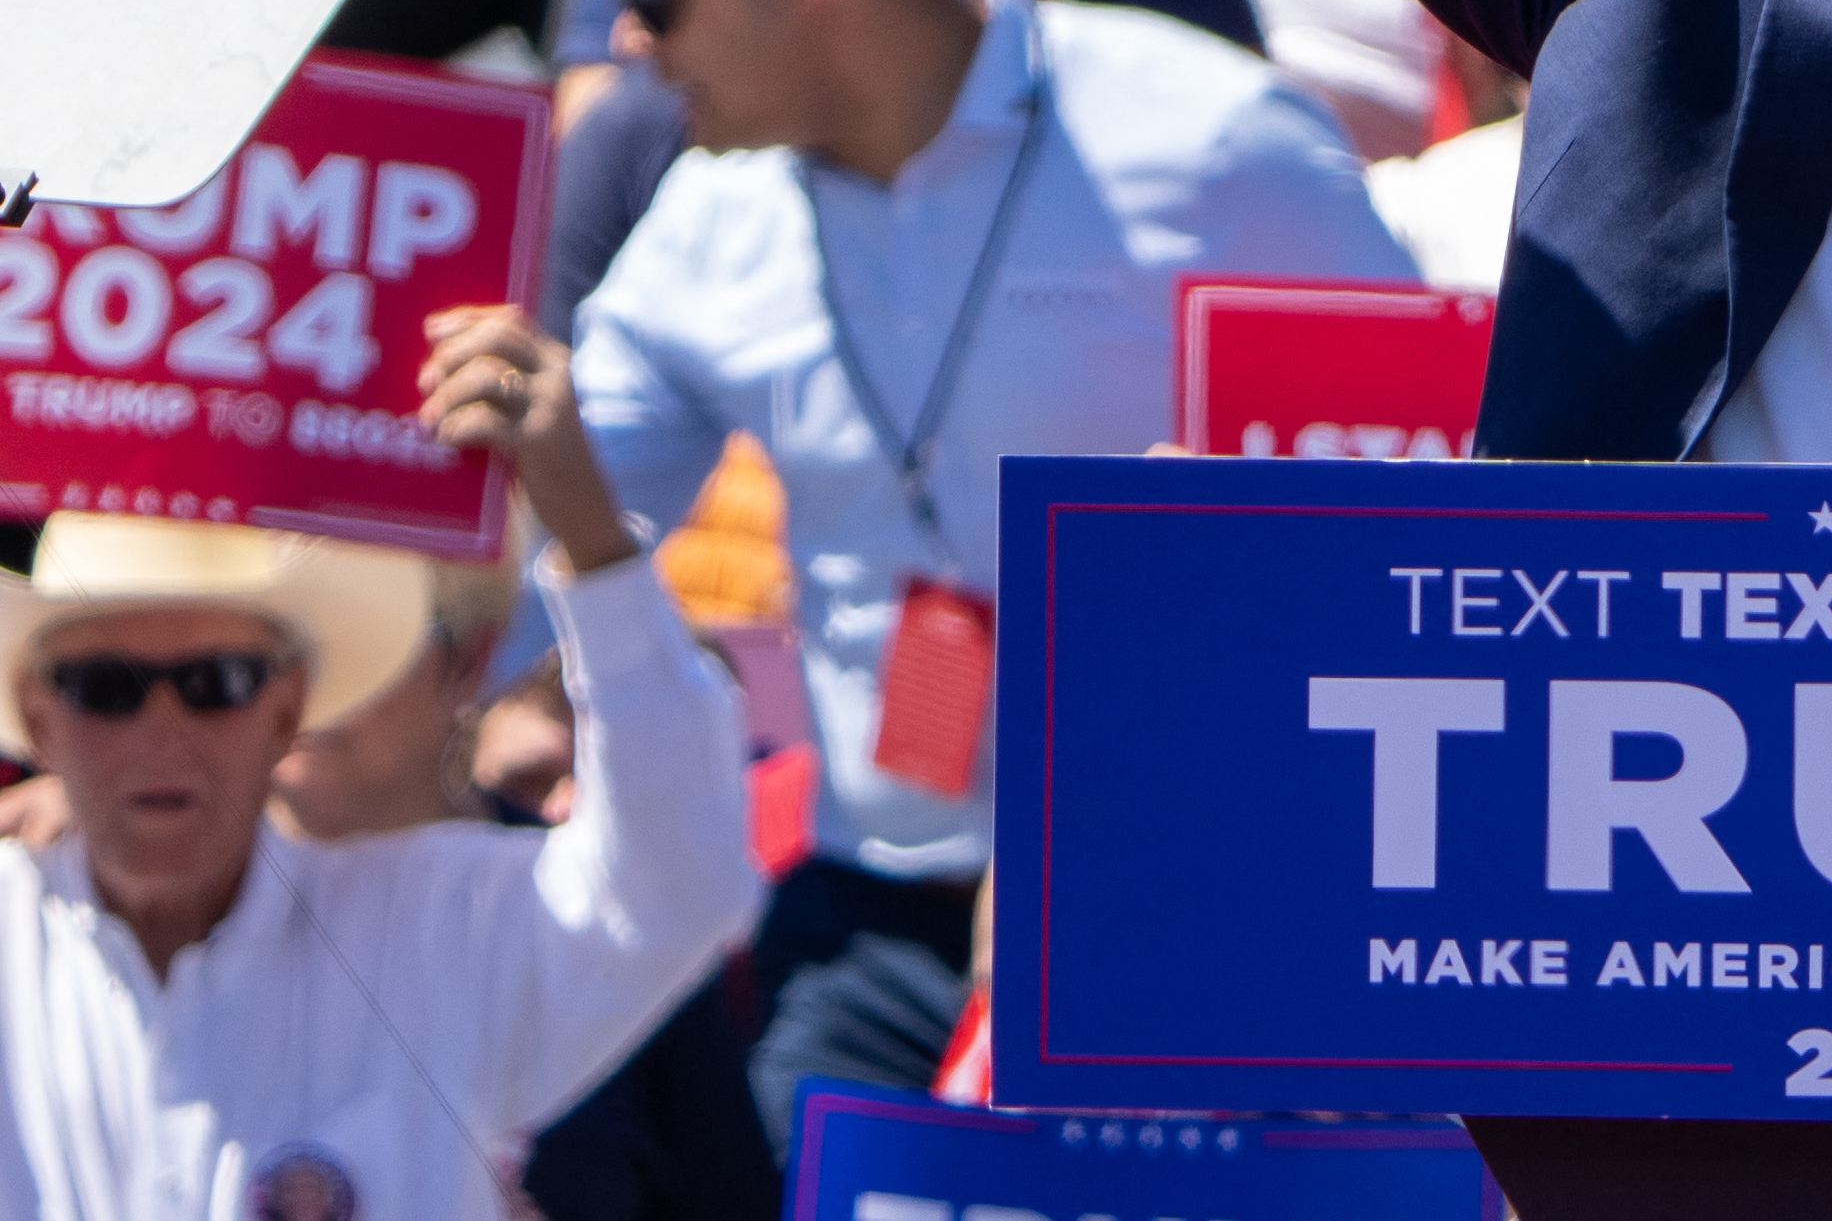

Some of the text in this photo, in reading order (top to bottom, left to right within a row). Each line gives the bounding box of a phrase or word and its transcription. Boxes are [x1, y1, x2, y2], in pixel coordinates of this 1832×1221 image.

[22, 141, 477, 278] UMP
[0, 236, 378, 392] 2024
[9, 373, 195, 434] TRUMP
[204, 389, 283, 445] TO
[1389, 567, 1630, 638] TEXT
[1368, 938, 1569, 986] MAKE
